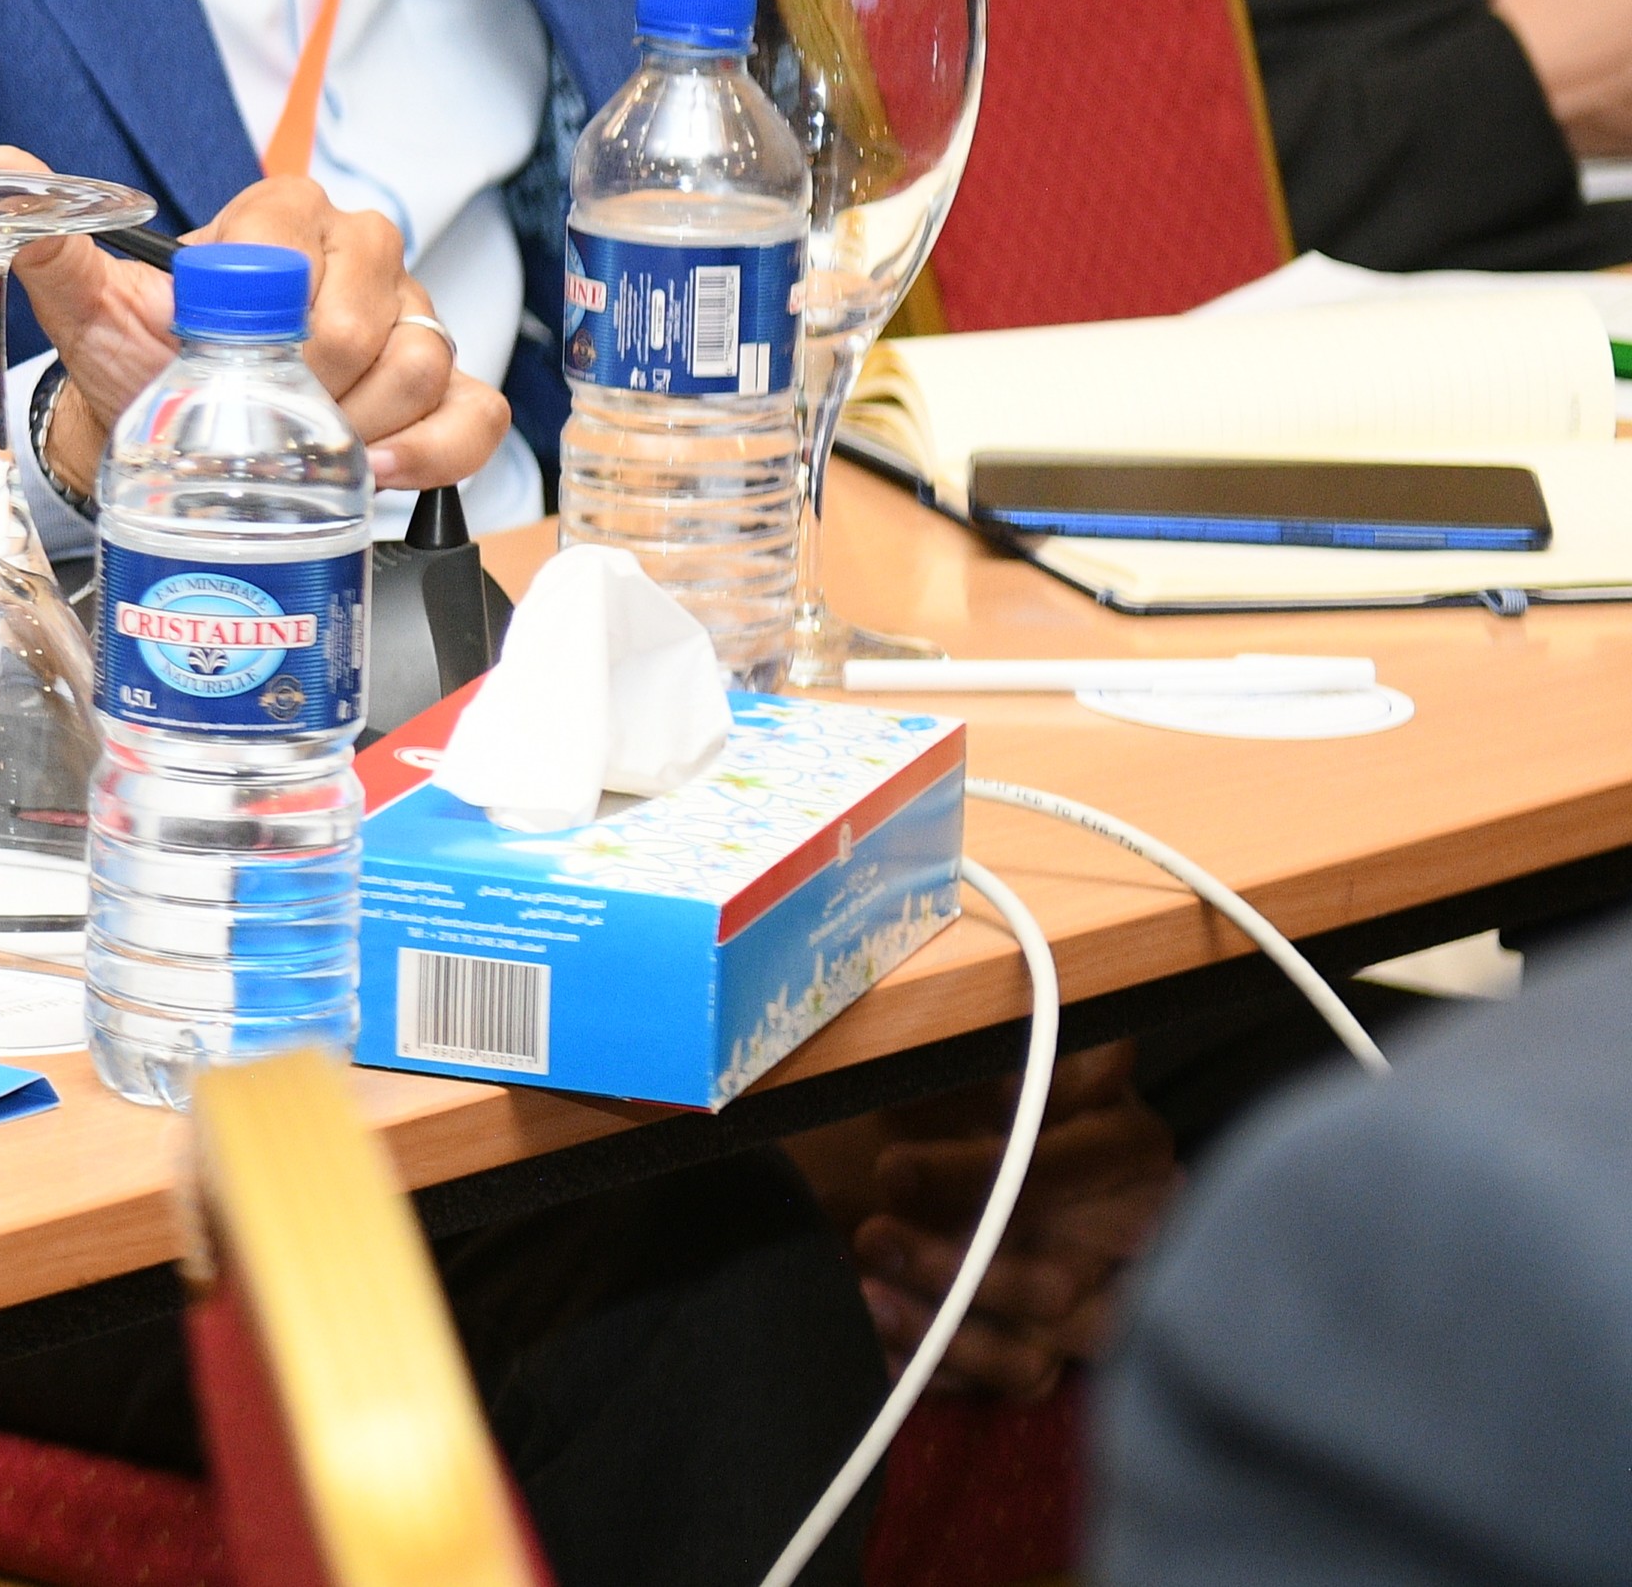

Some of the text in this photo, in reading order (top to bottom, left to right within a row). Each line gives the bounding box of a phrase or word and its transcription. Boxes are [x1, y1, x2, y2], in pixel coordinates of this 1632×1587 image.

[153, 577, 272, 613] EAU MINERALE
[121, 607, 311, 646] CRISTALINE
[162, 662, 263, 695] NATURELLE
